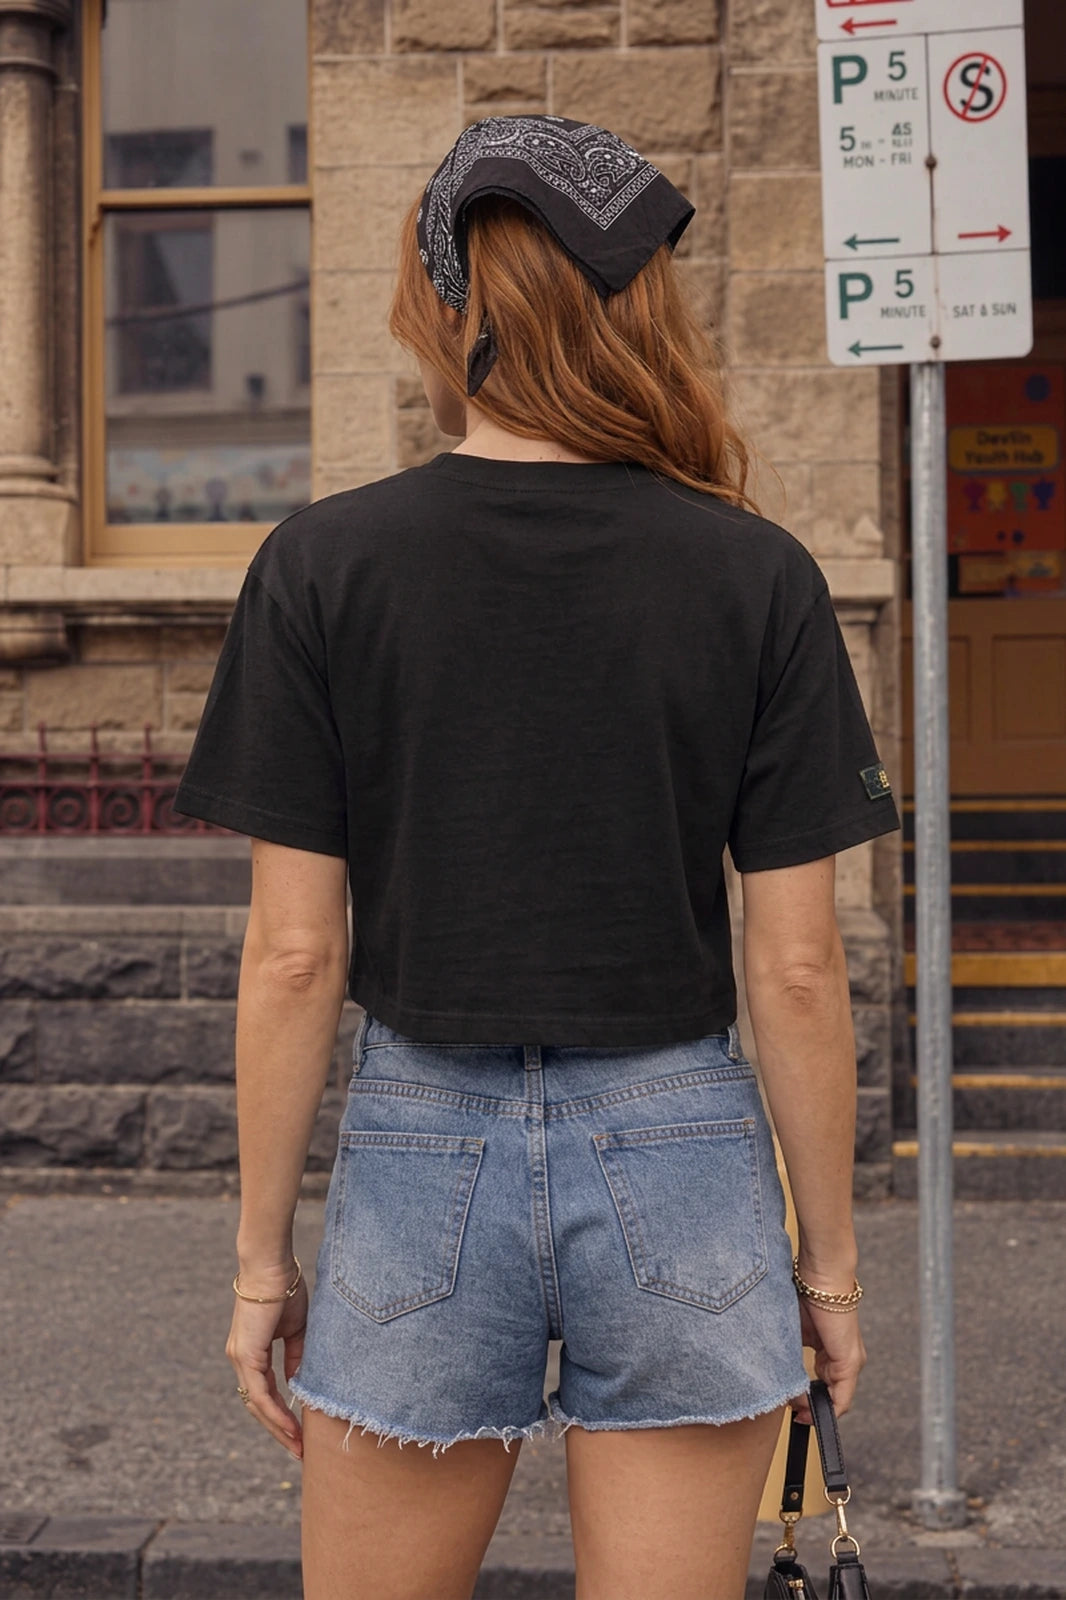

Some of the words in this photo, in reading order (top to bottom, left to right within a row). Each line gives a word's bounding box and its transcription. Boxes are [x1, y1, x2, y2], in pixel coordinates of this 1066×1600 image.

[888, 50, 907, 81] 5
[832, 55, 868, 105] P
[874, 87, 919, 102] MINUTE
[840, 126, 856, 152] 5
[843, 155, 874, 168] MON
[891, 151, 912, 166] FRI
[838, 272, 873, 320] P
[895, 269, 914, 299] 5
[880, 305, 926, 319] MINUTE
[953, 304, 976, 319] SAT
[980, 304, 988, 317] &
[992, 303, 1017, 316] SUN
